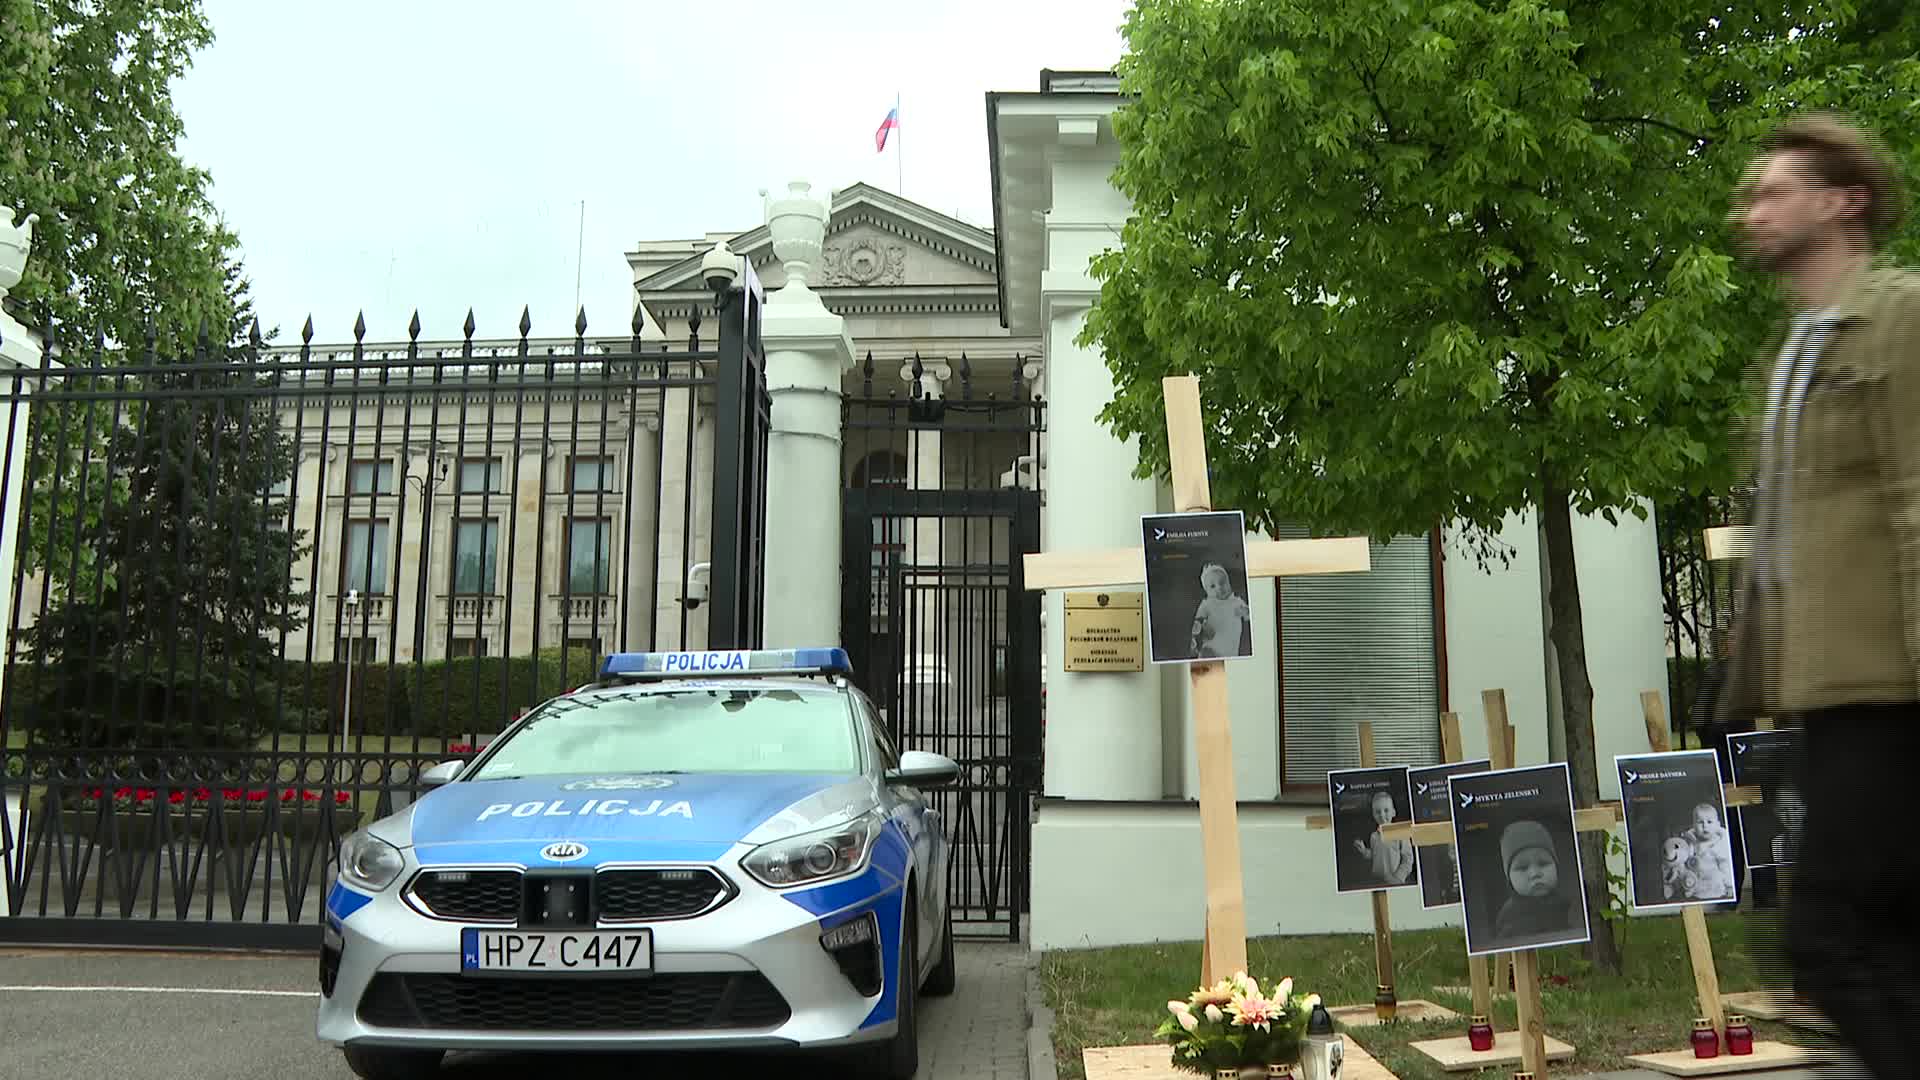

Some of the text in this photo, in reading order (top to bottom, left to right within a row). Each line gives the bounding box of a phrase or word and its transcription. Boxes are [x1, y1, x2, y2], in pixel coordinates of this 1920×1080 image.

[666, 652, 744, 671] POLICJA
[476, 799, 694, 822] POLICJA
[548, 844, 579, 856] KIA
[465, 953, 478, 964] PL
[485, 934, 643, 968] HPZ C447
